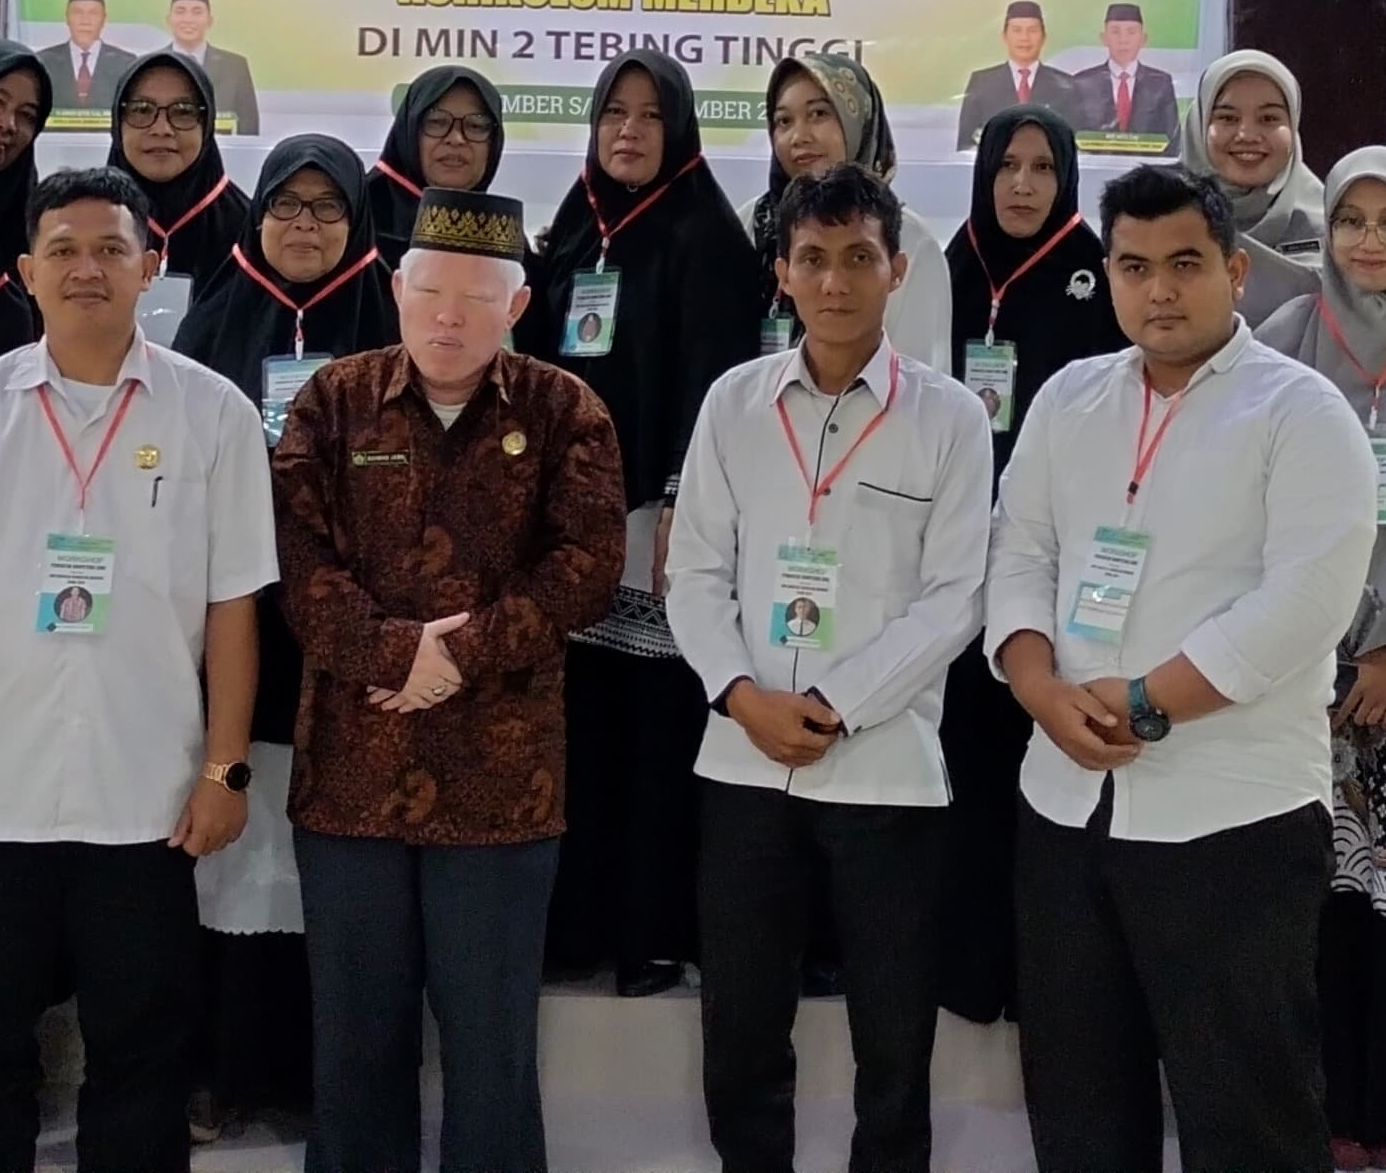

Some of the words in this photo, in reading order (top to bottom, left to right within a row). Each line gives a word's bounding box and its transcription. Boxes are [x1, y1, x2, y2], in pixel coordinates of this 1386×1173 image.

[357, 25, 401, 58] DI
[415, 28, 499, 59] MIN
[511, 30, 535, 59] 2
[502, 94, 563, 116] MBER
